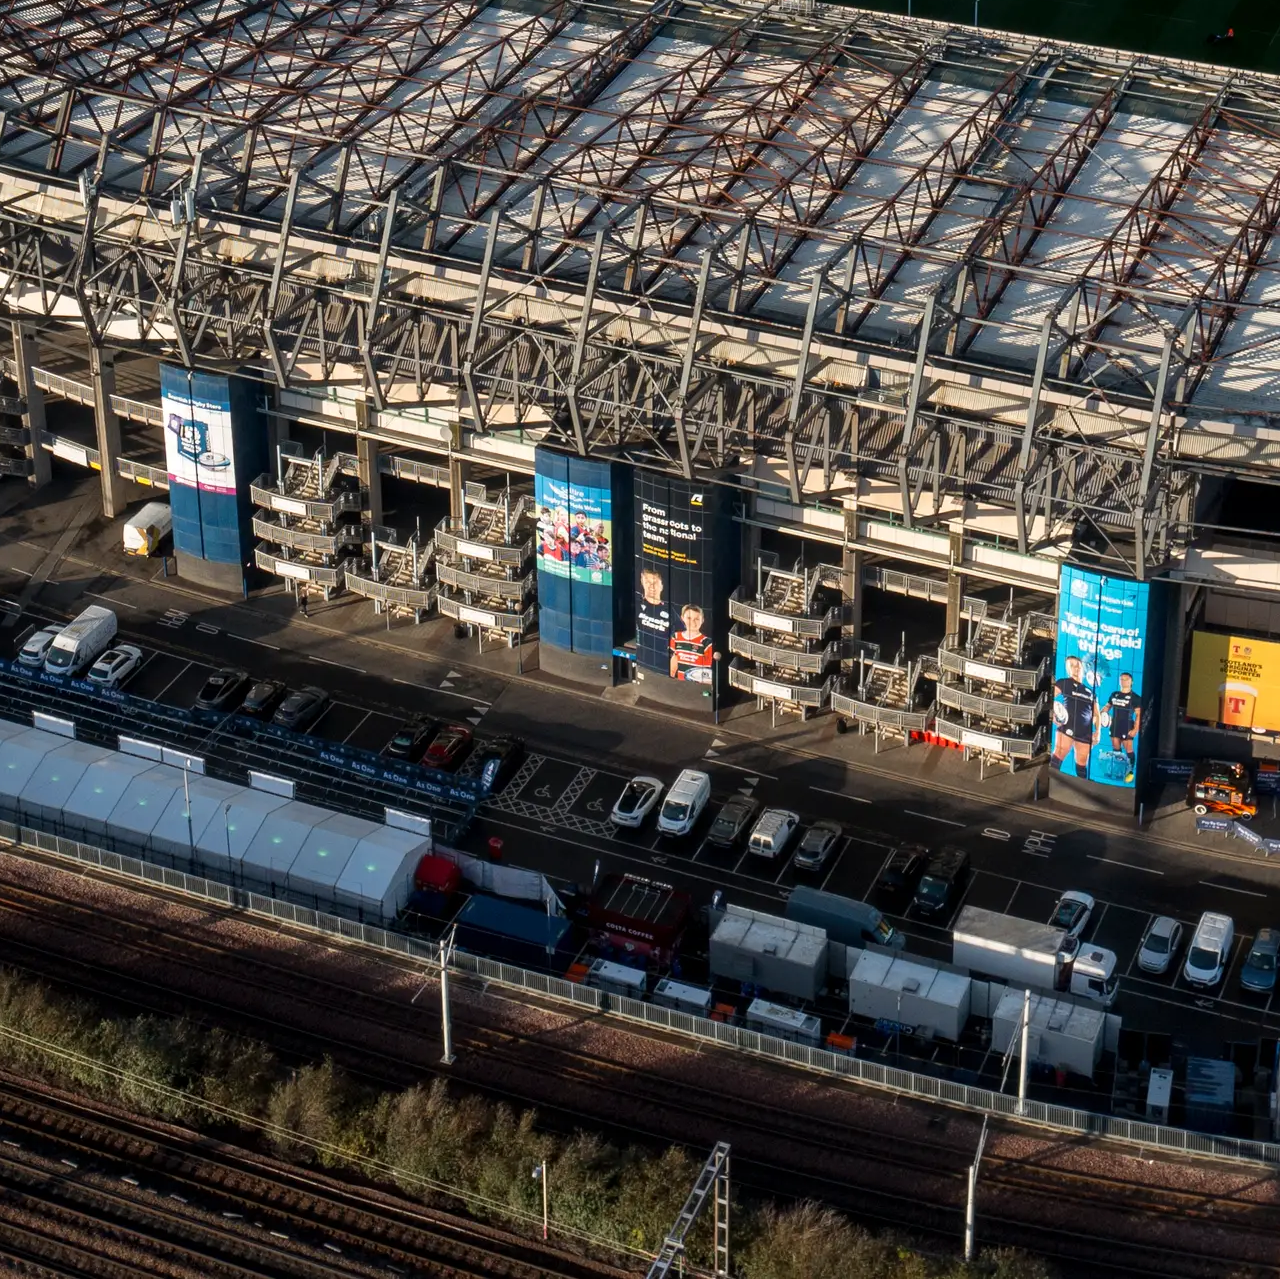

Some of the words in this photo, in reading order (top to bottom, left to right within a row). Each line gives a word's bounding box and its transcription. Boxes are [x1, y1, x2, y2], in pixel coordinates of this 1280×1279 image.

[642, 503, 666, 517] From
[642, 513, 689, 531] grassroots
[691, 524, 702, 533] to
[642, 522, 657, 532] the
[642, 530, 668, 544] team.
[156, 608, 191, 629] MPH
[1064, 611, 1098, 631] Taking
[1100, 624, 1125, 636] care
[1126, 627, 1140, 637] of
[195, 621, 221, 635] 10
[1061, 620, 1142, 649] Murrayfield
[1078, 639, 1122, 660] things
[1232, 645, 1241, 653] T
[1220, 658, 1263, 669] SCOTLAND'S
[1224, 663, 1258, 673] ORIGINAL
[10, 664, 19, 672] As
[19, 667, 32, 677] One
[1220, 668, 1261, 678] SUPPORTER
[40, 673, 49, 681] As
[49, 675, 63, 685] One
[71, 680, 80, 689] As
[80, 683, 94, 692] One
[101, 688, 110, 697] As
[110, 691, 125, 700] One
[1228, 697, 1246, 714] T
[320, 751, 330, 761] As
[330, 754, 344, 765] One
[351, 761, 361, 770] As
[361, 764, 376, 775] One
[383, 772, 392, 780] As
[393, 774, 408, 784] One
[416, 781, 425, 790] As
[426, 783, 441, 793] One
[450, 788, 460, 797] As
[460, 791, 475, 801] One
[981, 828, 1011, 841] 10
[1021, 829, 1058, 858] MPH
[605, 922, 627, 933] COSTA
[628, 928, 655, 941] COFFEE
